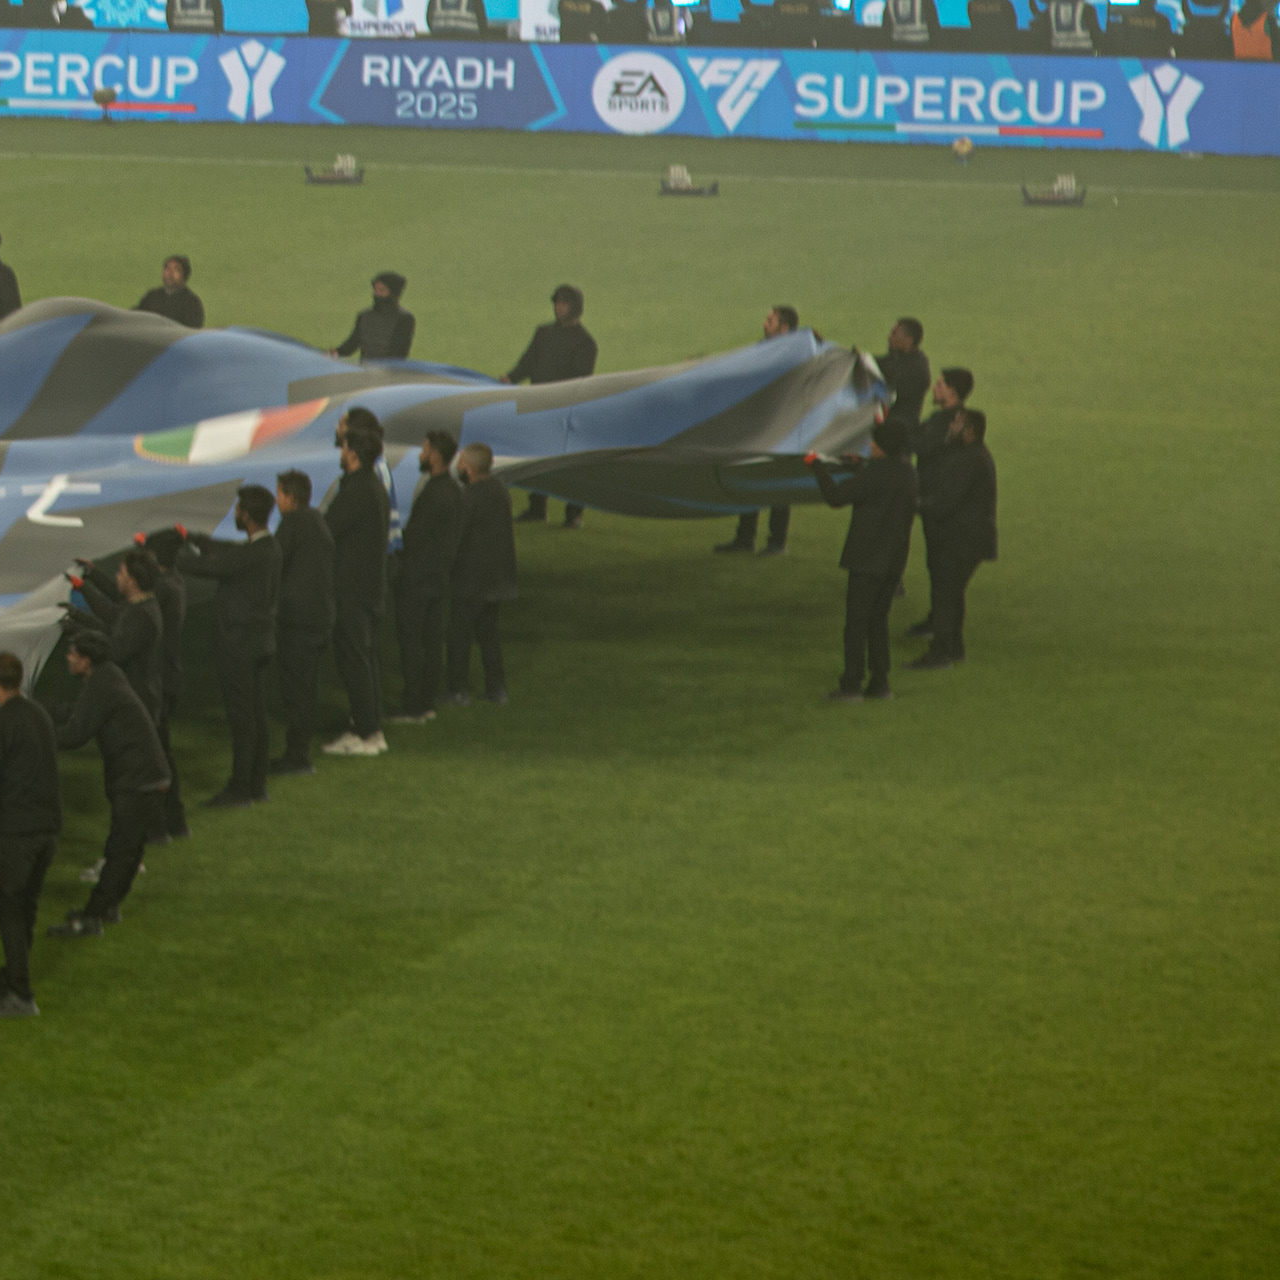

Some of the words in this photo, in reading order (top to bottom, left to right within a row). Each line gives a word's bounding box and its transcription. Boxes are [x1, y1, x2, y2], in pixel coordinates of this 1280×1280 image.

[362, 55, 515, 90] RIYADH
[612, 70, 666, 97] EA
[395, 90, 477, 119] 2025
[687, 57, 781, 133] FC
[794, 73, 1107, 125] SUPERCUP
